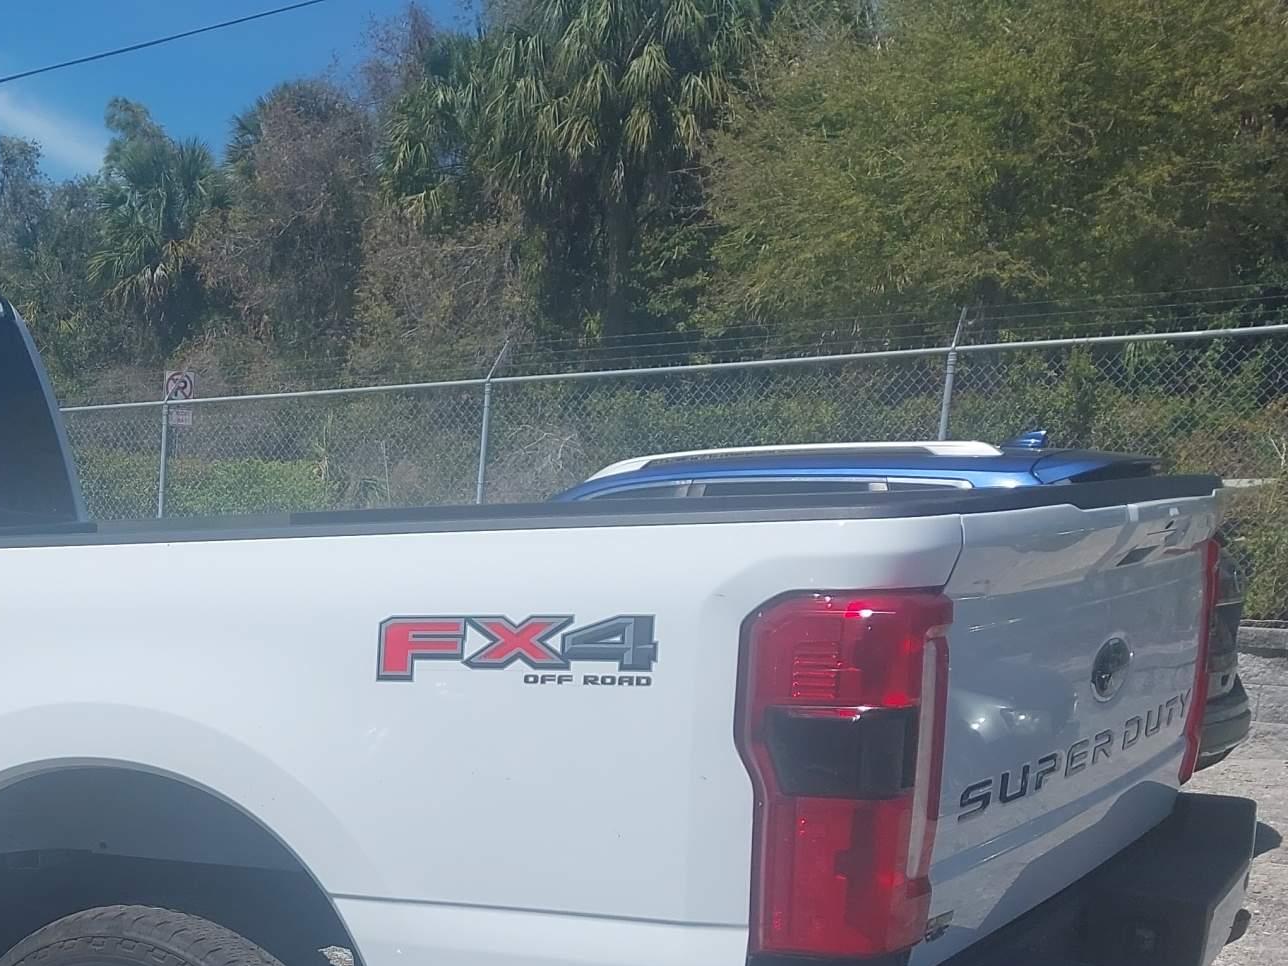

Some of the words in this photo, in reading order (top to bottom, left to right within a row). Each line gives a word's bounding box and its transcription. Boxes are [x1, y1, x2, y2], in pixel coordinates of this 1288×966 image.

[376, 613, 659, 683] FX4
[523, 673, 574, 686] OFF
[582, 674, 653, 687] ROAD
[956, 728, 1115, 823] SUPER
[1121, 687, 1192, 752] DUTY
